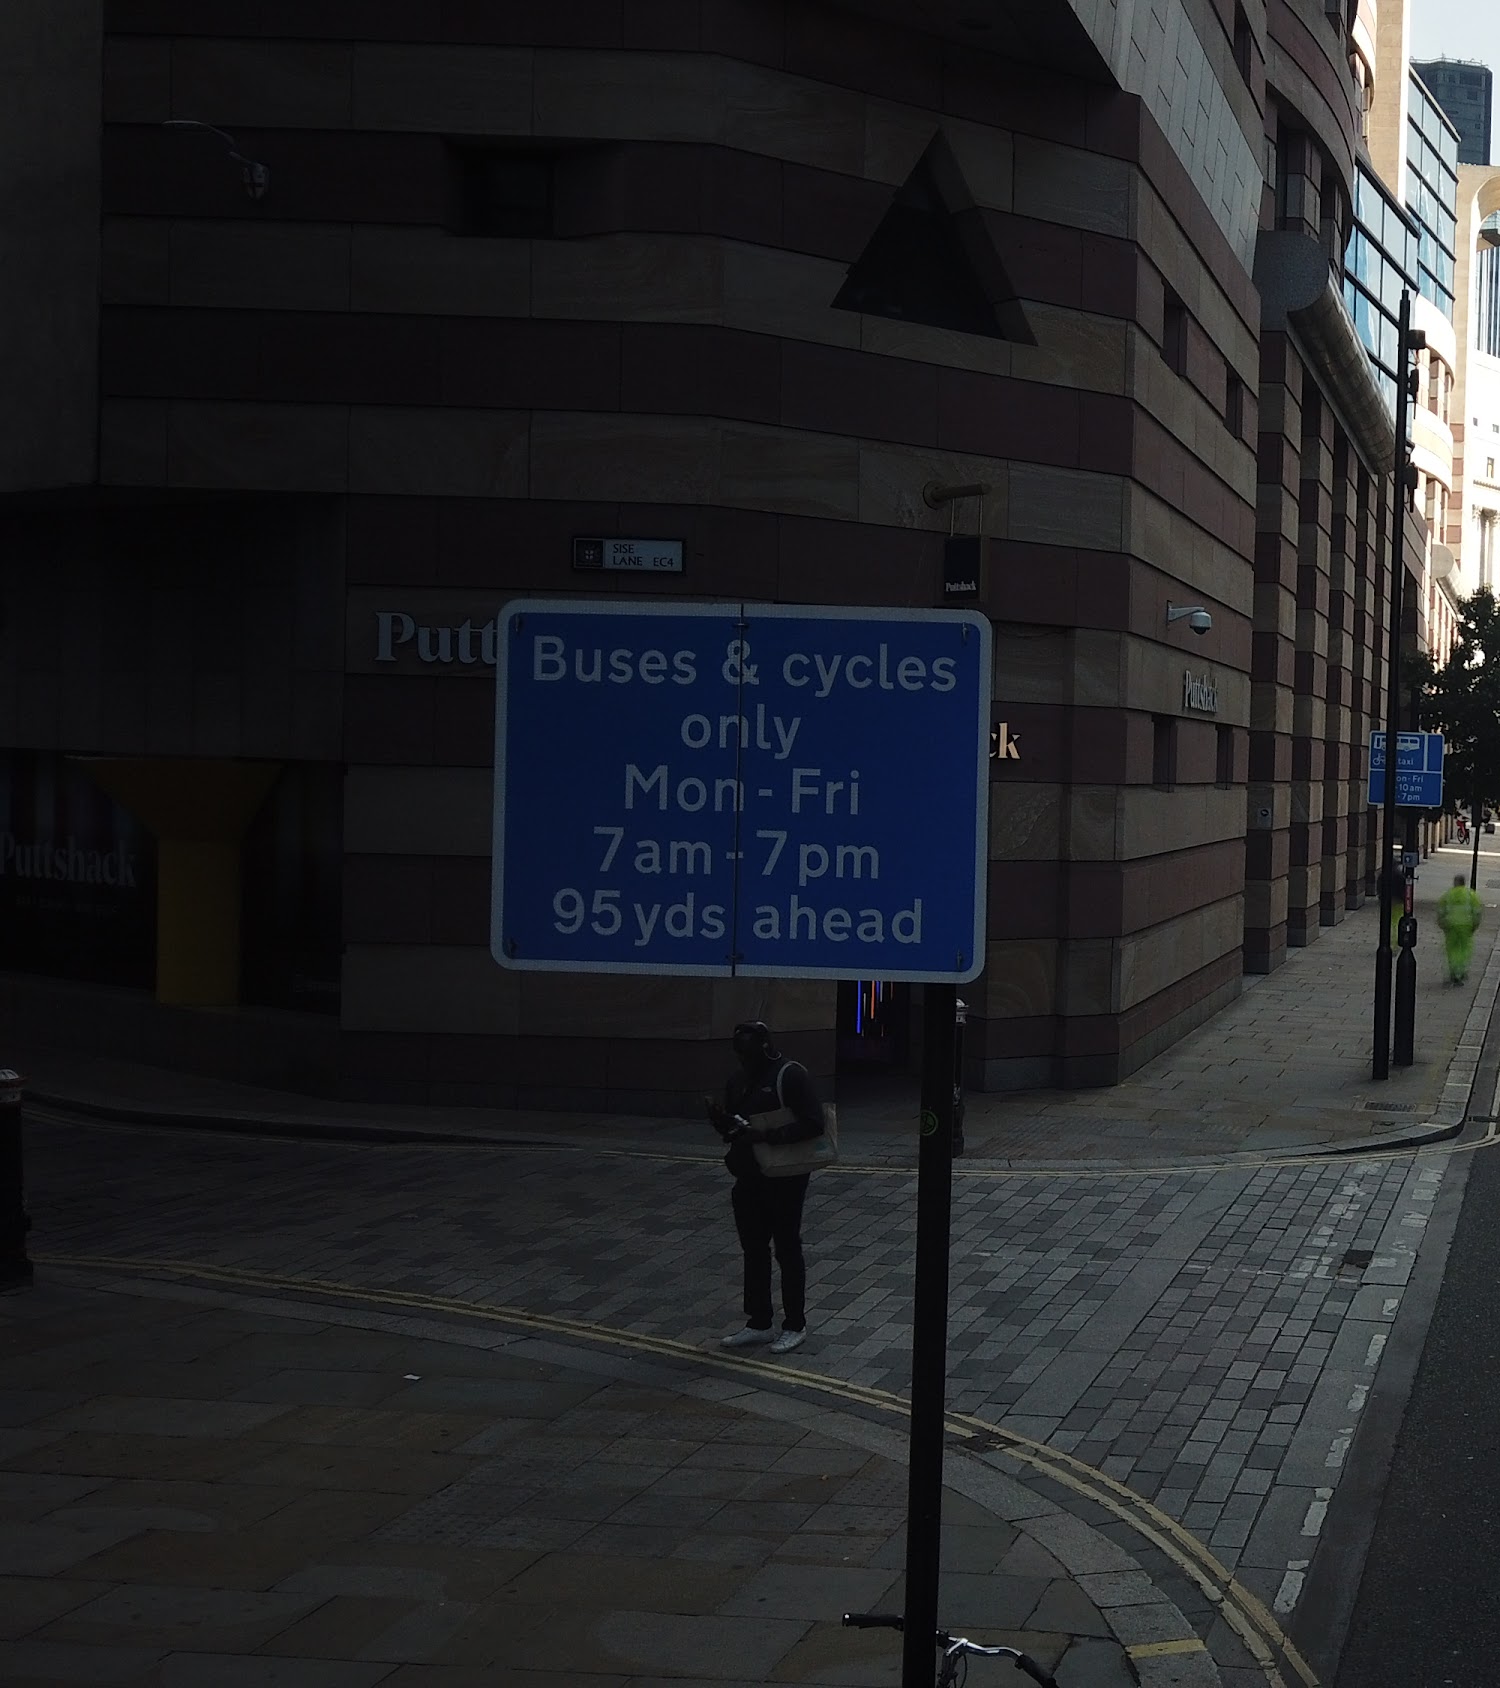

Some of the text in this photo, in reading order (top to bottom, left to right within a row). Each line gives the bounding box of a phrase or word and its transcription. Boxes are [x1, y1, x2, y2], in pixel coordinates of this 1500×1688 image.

[612, 543, 634, 554] SISE
[612, 556, 643, 566] LANE
[653, 557, 674, 567] EC4
[533, 635, 957, 698] Buses & cycles
[680, 703, 802, 760] only
[1397, 757, 1414, 766] taxi
[752, 894, 922, 945] ahead
